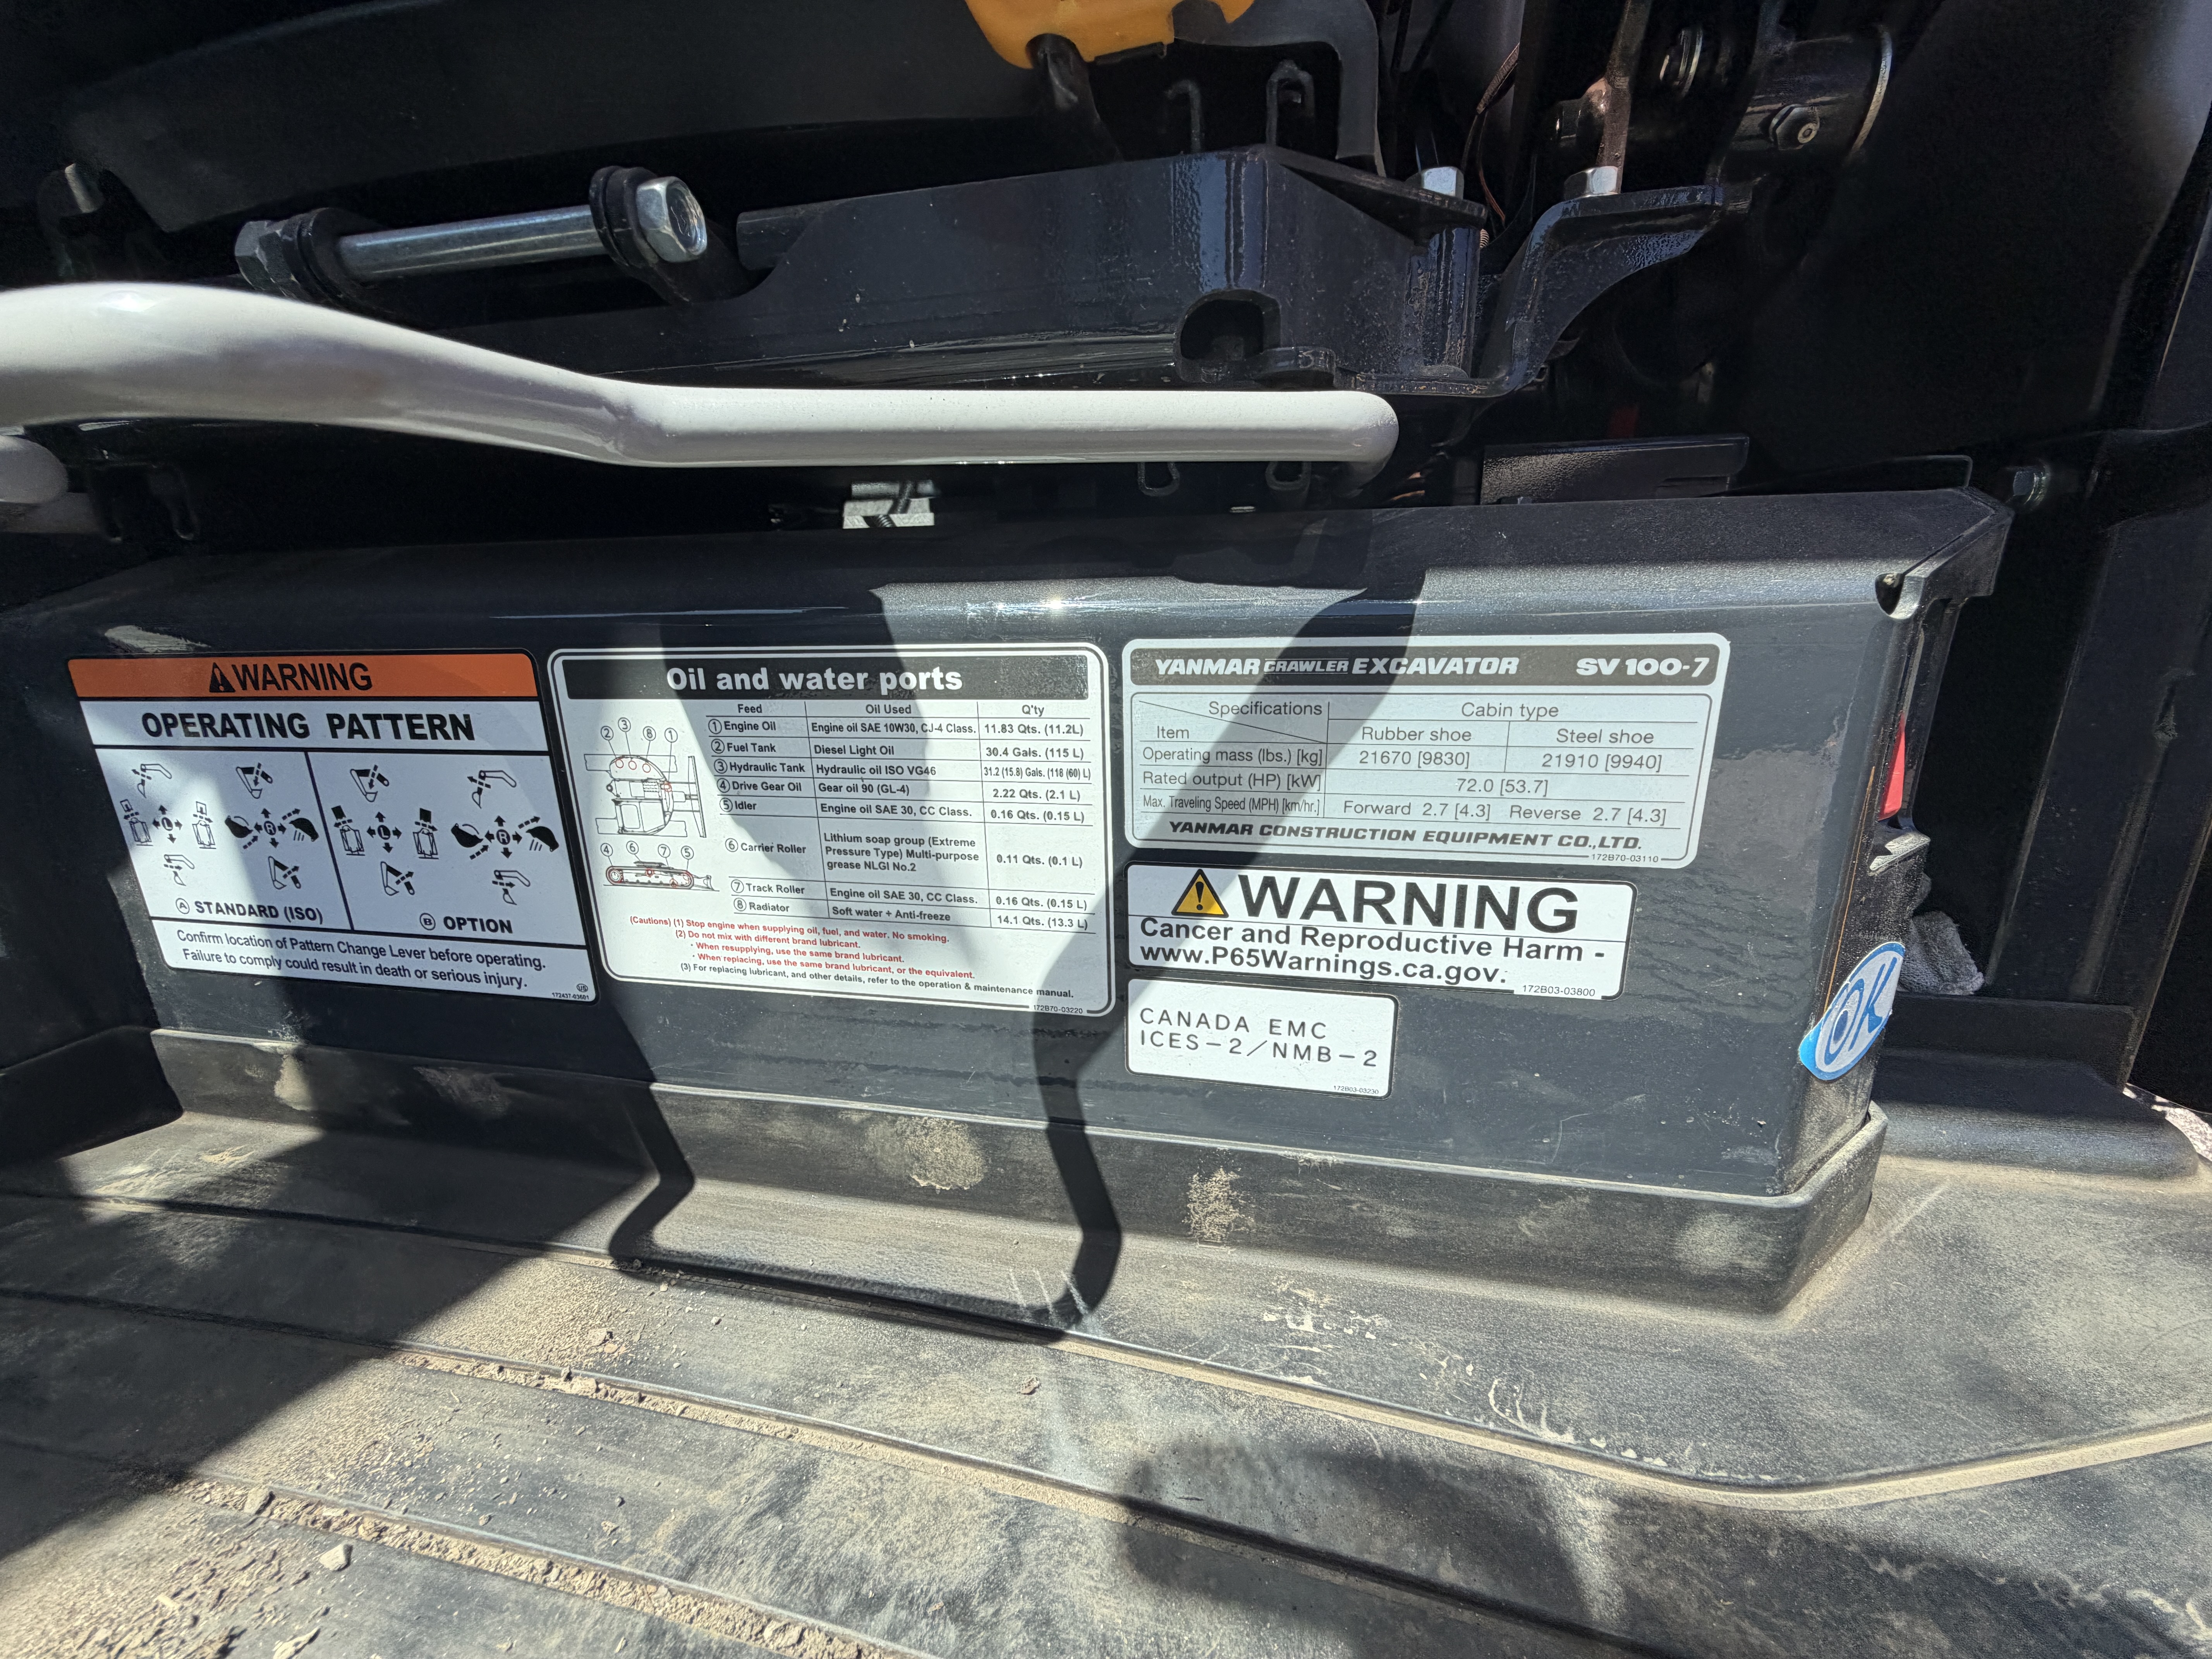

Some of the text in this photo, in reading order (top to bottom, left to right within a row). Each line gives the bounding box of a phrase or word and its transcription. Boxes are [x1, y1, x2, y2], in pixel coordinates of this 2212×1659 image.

[1155, 658, 1519, 675] YANMAR CRAWLER EXCAVATOR
[232, 663, 373, 691] WARNING
[667, 666, 962, 695] Oil and water ports
[738, 704, 762, 713] Feed
[866, 704, 911, 714] Oil Used
[1022, 705, 1044, 717] Q'ty
[1209, 701, 1322, 718] Specifications
[1462, 702, 1559, 721] Cabin type
[142, 713, 475, 740] OPERATING PATTERN
[724, 721, 776, 732] Engine Oil
[811, 723, 976, 734] Engine oil SAE 10W30, CJ-4 Class.
[984, 724, 1013, 733] 11.83
[1018, 724, 1041, 734] Qts.
[1157, 725, 1189, 739] Item
[1362, 726, 1472, 741] Rubber shoe
[1556, 728, 1654, 744] Steel shoe
[727, 743, 776, 752] Fuel Tank
[814, 745, 894, 757] Diesel Light Oil
[986, 747, 1084, 761] 30.4 Gals. (115 L)
[1143, 747, 1322, 766] Operating mass (lbs.) [kg]
[1359, 750, 1470, 769] 21670 [9830]
[1542, 754, 1662, 773] 21910 [9940]
[730, 762, 805, 773] Hydraulic Tank
[732, 781, 802, 791] Drive Gear Oil
[819, 783, 909, 796] Gear oil 90 (GL-4)
[1144, 771, 1321, 792] Rated output (HP) [kW]
[1456, 778, 1548, 797] 72.0 [53.7]
[735, 801, 757, 810] Idler
[1144, 795, 1319, 816] Max. Traveling Speed (MPH) [km/hr.]
[1344, 800, 1491, 821] Forward 2.7 [4.3]
[1510, 805, 1666, 826] Reverse 2.7 [4.3]
[824, 833, 975, 848] Lithium soap group (Extreme
[1169, 821, 1642, 849] YANMAR CONSTRUCTION EQUIPMENT CO.,LTD.
[741, 842, 806, 854] Carrier Roller
[825, 846, 979, 862] Pressure Type) Multi-purpose
[827, 861, 917, 871] grease NLGI No.2
[1592, 854, 1658, 862] 172B70-03110
[745, 883, 805, 894] Track Roller
[749, 902, 790, 912] Radiator
[1238, 875, 1578, 933] WARNING
[194, 901, 279, 918] STANDARD
[284, 906, 323, 924] (ISO)
[832, 907, 853, 915] Soft
[855, 909, 883, 917] water
[895, 910, 950, 921] Anti-freeze
[443, 916, 513, 934] OPTION
[676, 930, 685, 939] (2)
[754, 935, 790, 944] different
[792, 937, 817, 945] brand
[819, 939, 860, 948] lubricant.
[1140, 917, 1233, 941] Cancer
[1242, 926, 1290, 944] and
[1301, 926, 1492, 957] Reproductive
[1503, 937, 1583, 961] Harm
[177, 930, 546, 971] Confirm location of Pattern Change Lever before operating.
[182, 948, 527, 989] Failure to comply could result in death or serious injury.
[1140, 945, 1506, 985] www.P65Warnings.ca.gov.
[1523, 985, 1595, 996] 172B03-03800
[1034, 1005, 1083, 1013] 172B70-03220
[1824, 957, 1898, 1065] OK
[1140, 1008, 1326, 1039] CANADA EMC
